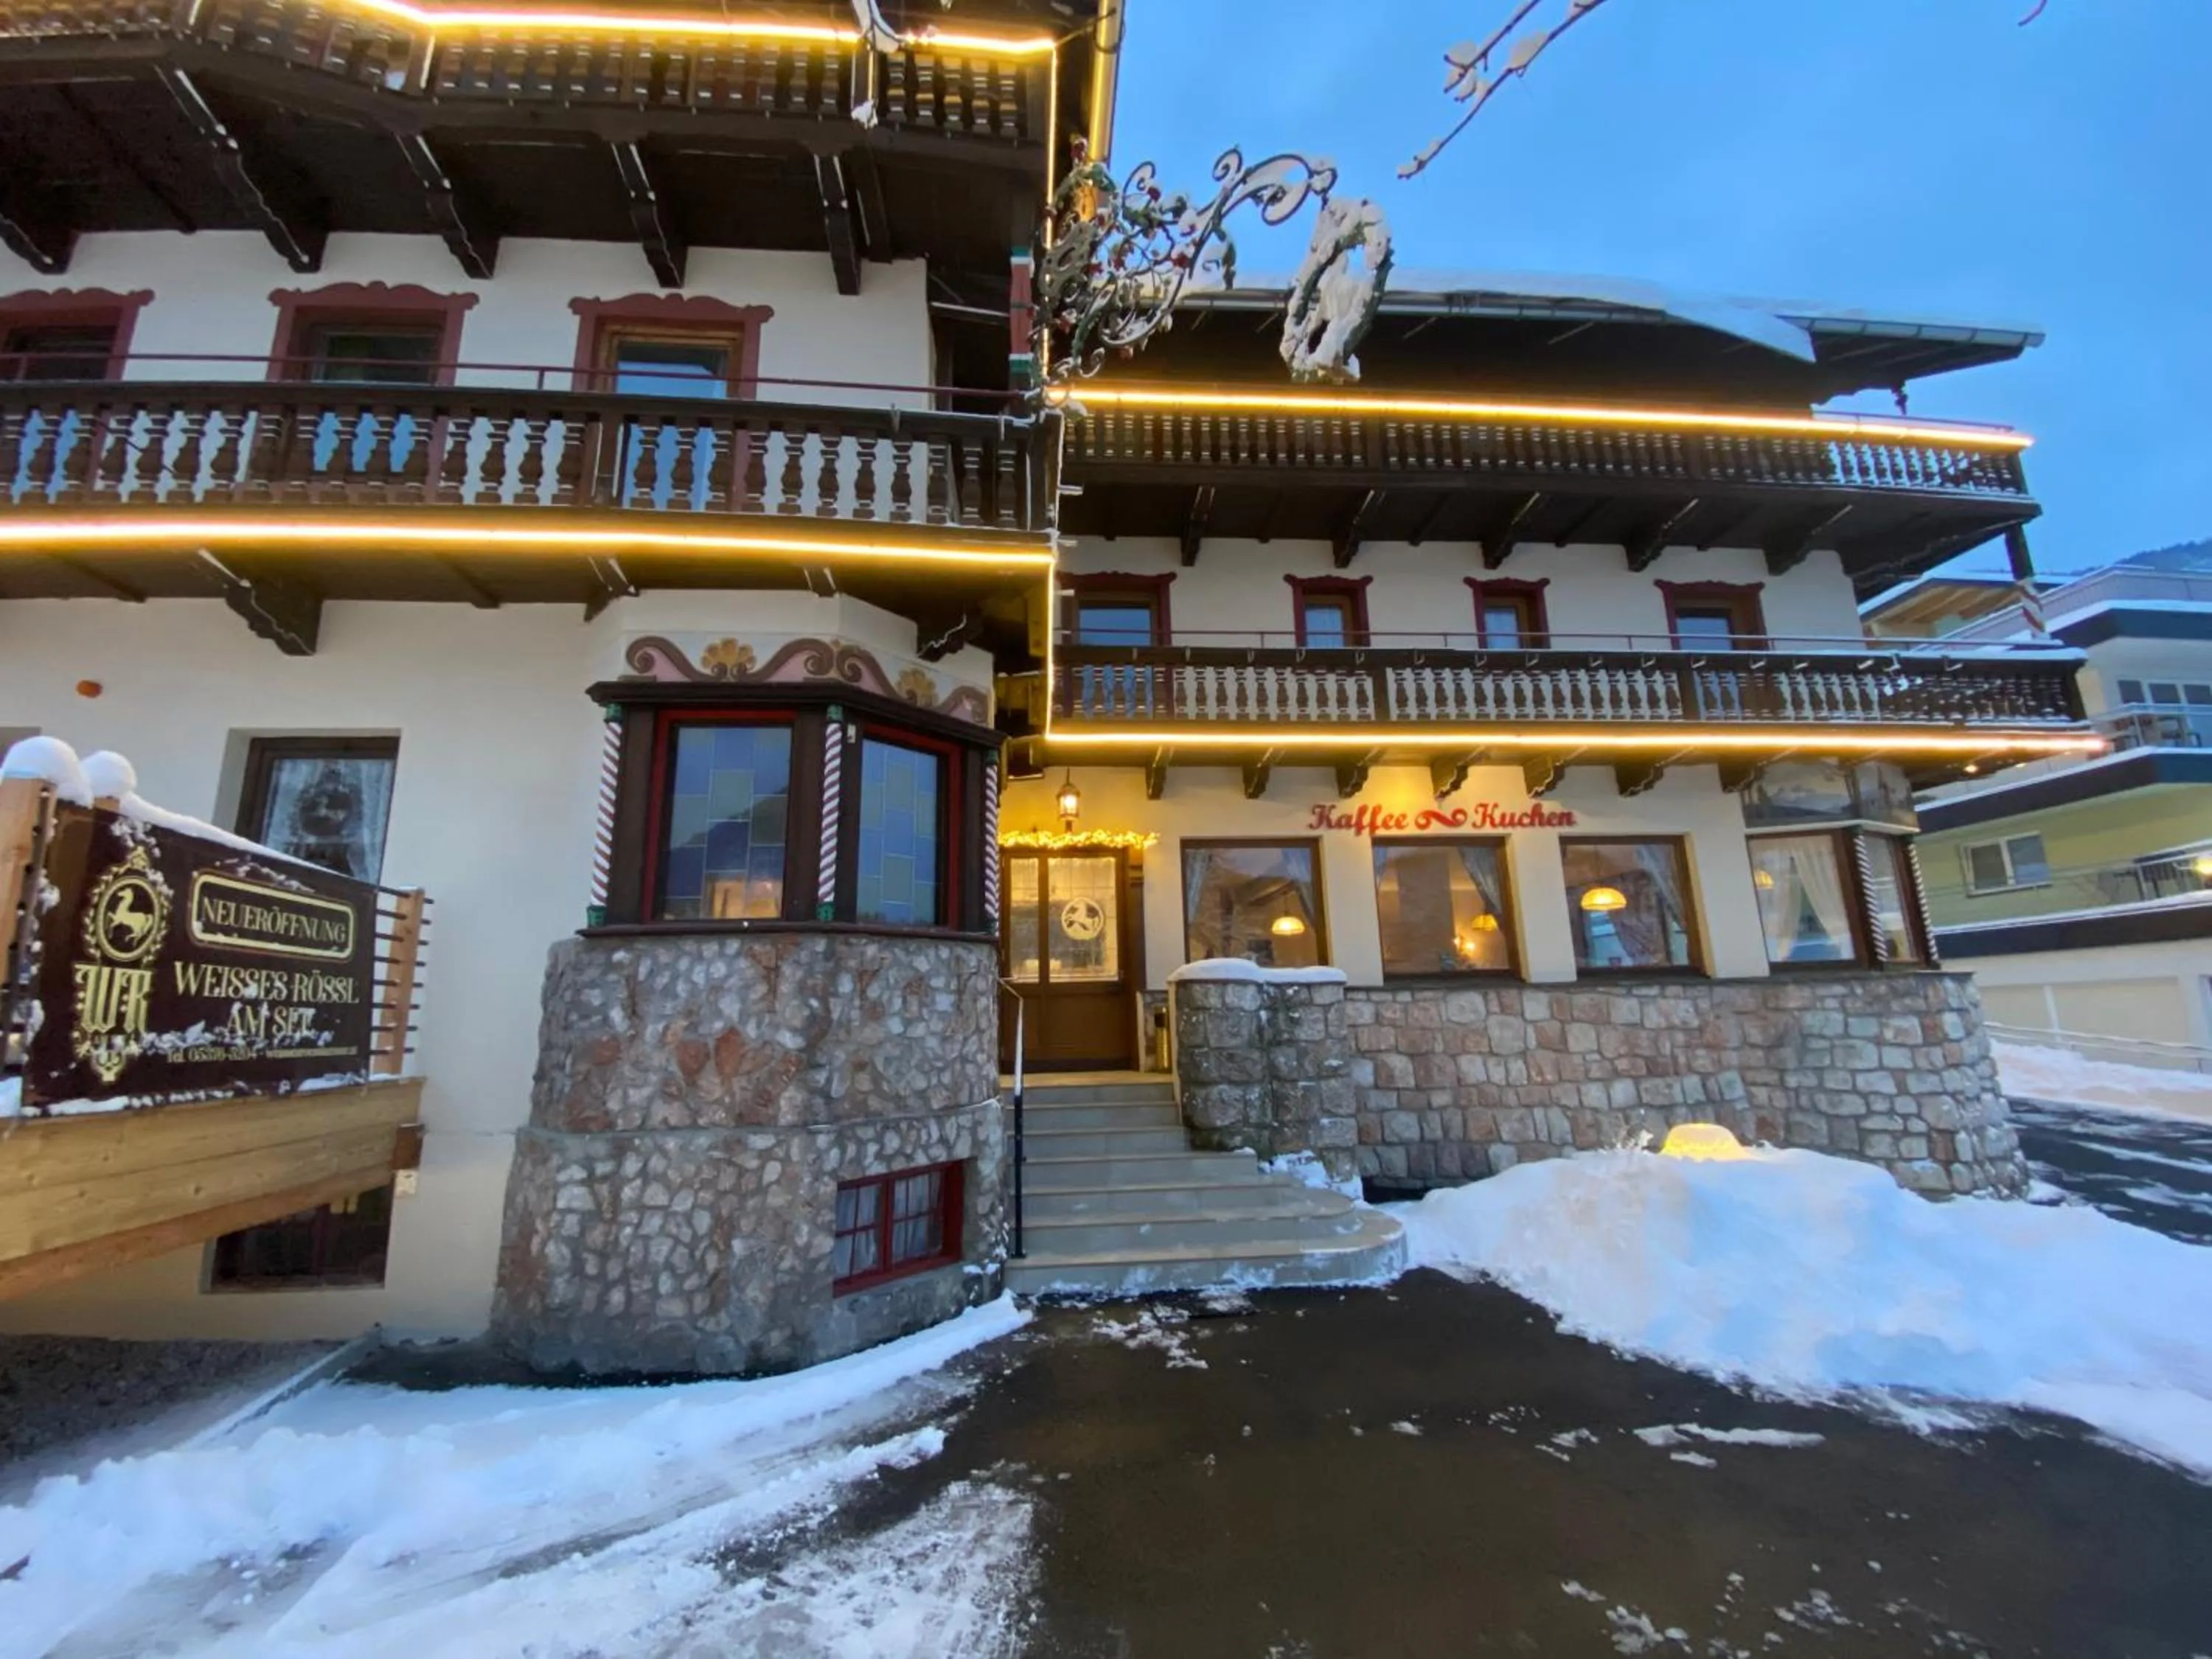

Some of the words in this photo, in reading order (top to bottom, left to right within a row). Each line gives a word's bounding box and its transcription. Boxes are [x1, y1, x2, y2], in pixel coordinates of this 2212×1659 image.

[1309, 803, 1409, 836] Kaffee
[1471, 802, 1579, 829] Kuchen
[202, 896, 346, 943] NEUERÖFFNUNG
[175, 961, 288, 1001] WEISSES
[293, 970, 359, 1004] RÖSSL
[227, 1002, 266, 1040] AM
